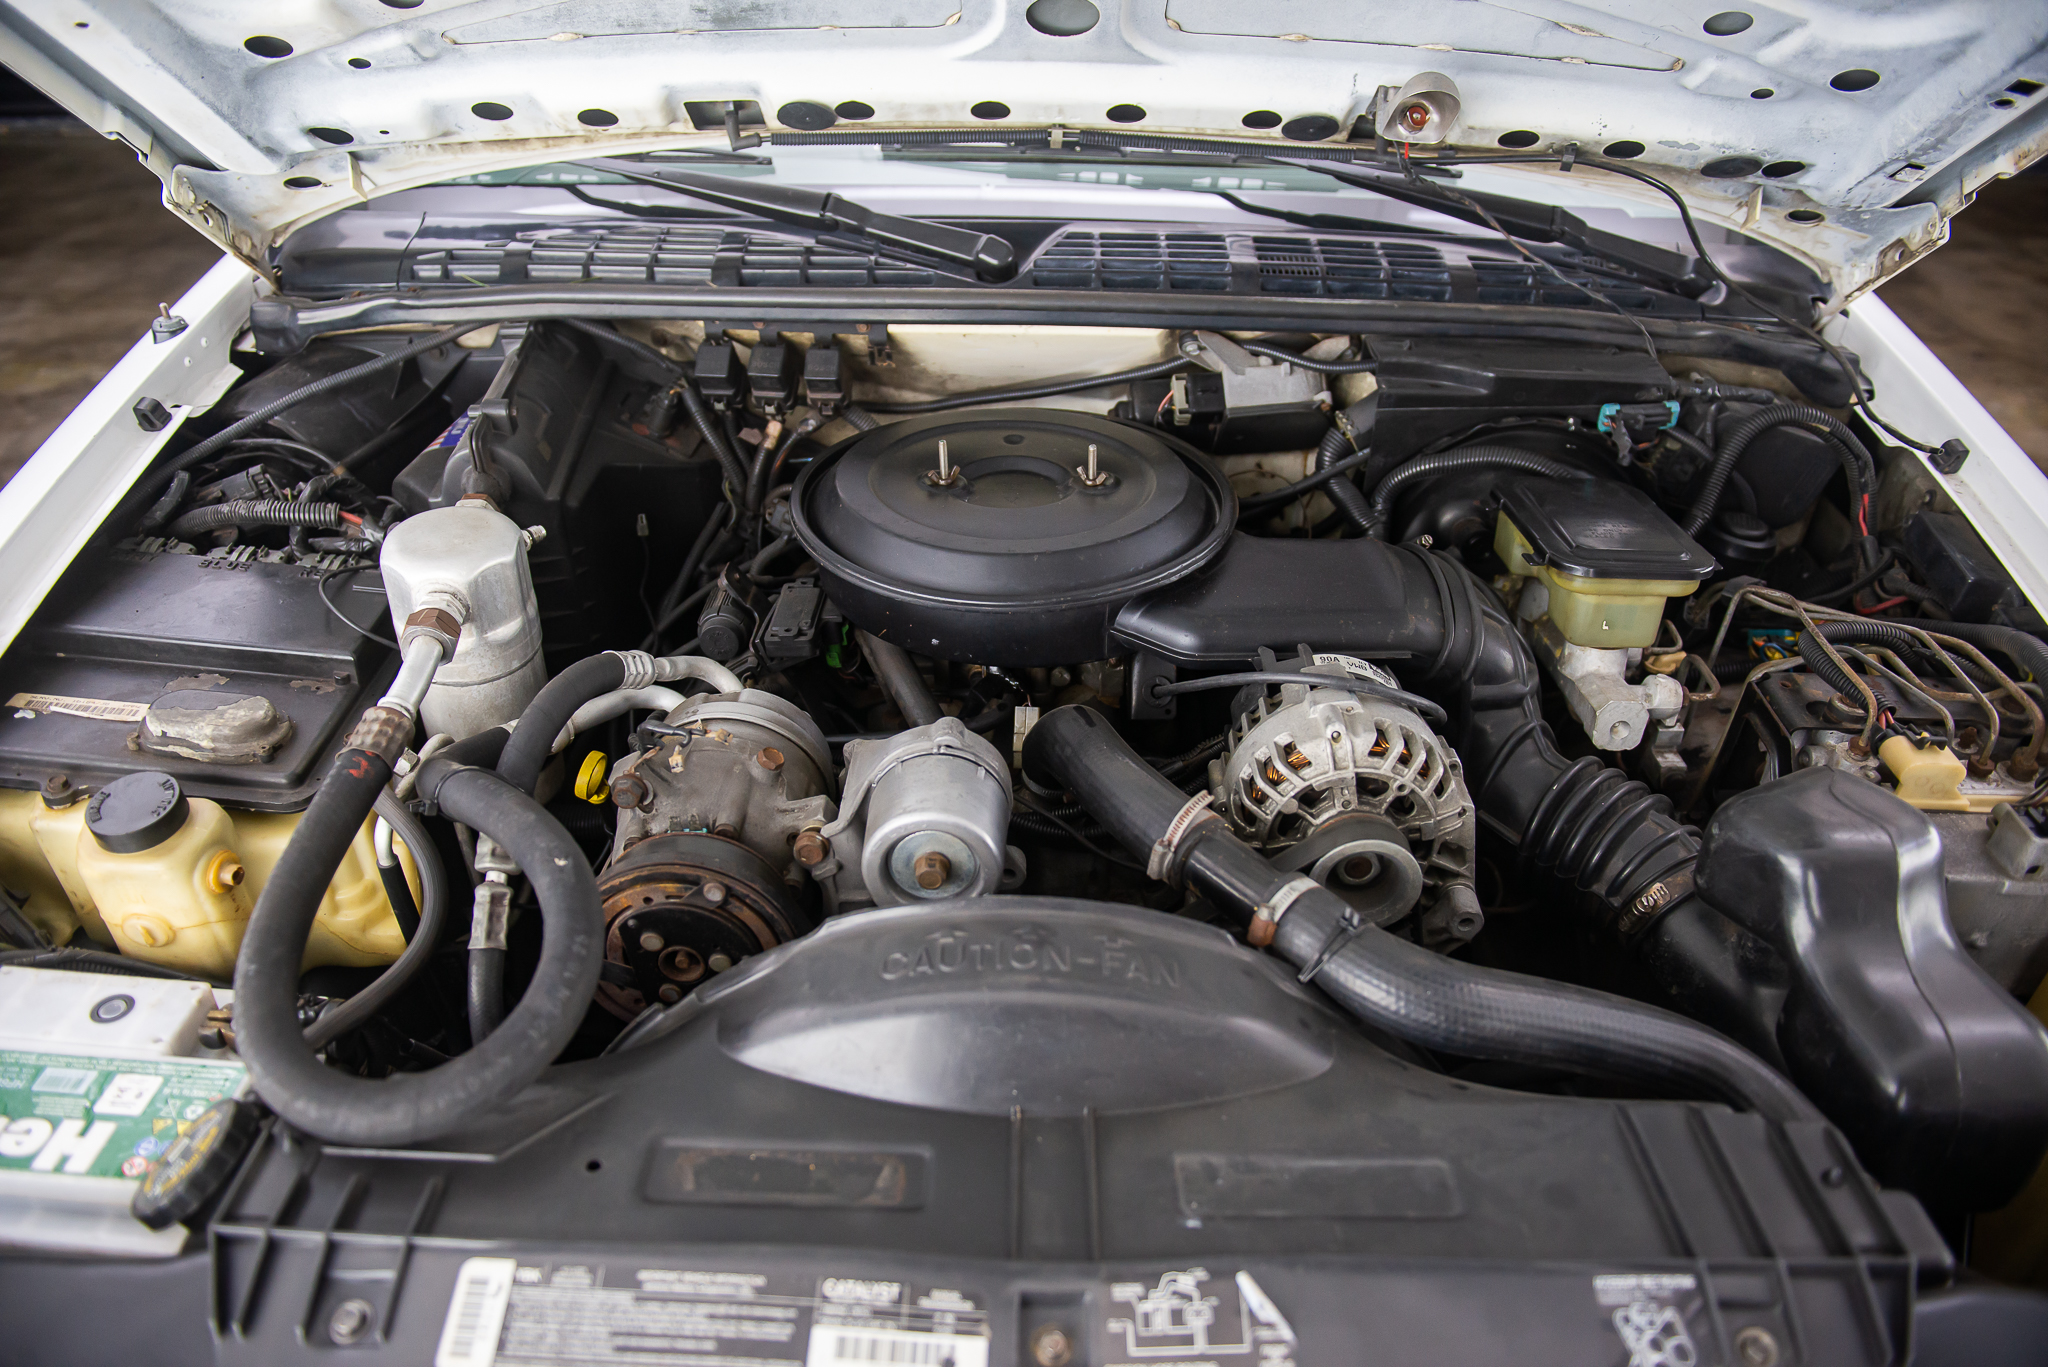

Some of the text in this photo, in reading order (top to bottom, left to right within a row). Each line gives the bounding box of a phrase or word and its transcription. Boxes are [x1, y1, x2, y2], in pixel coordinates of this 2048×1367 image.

[198, 559, 252, 572] BLUE
[299, 568, 325, 579] RE
[1319, 656, 1341, 664] 90A
[0, 1114, 117, 1174] He
[822, 1277, 902, 1303] CATALYST
